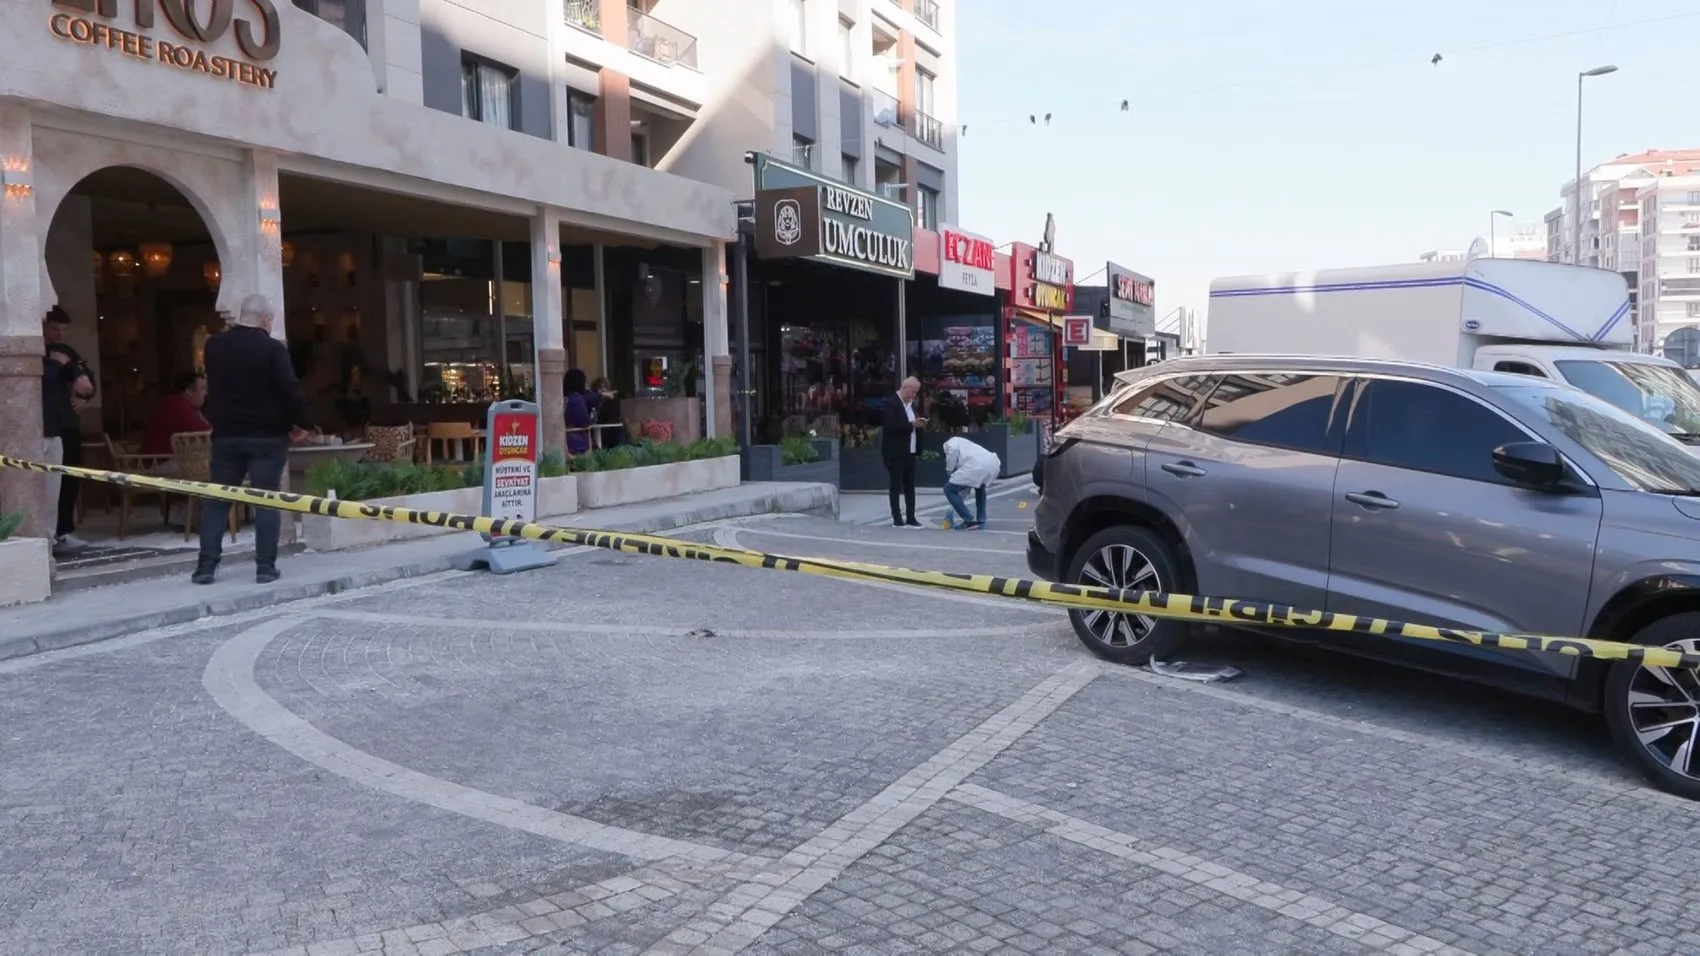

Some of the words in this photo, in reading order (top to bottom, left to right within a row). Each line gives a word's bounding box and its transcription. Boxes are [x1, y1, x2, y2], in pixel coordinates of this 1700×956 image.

[49, 13, 153, 59] COFFEE
[157, 40, 278, 89] ROASTERY
[825, 187, 873, 220] REVZEN
[1070, 322, 1085, 341] E
[523, 465, 531, 473] VE
